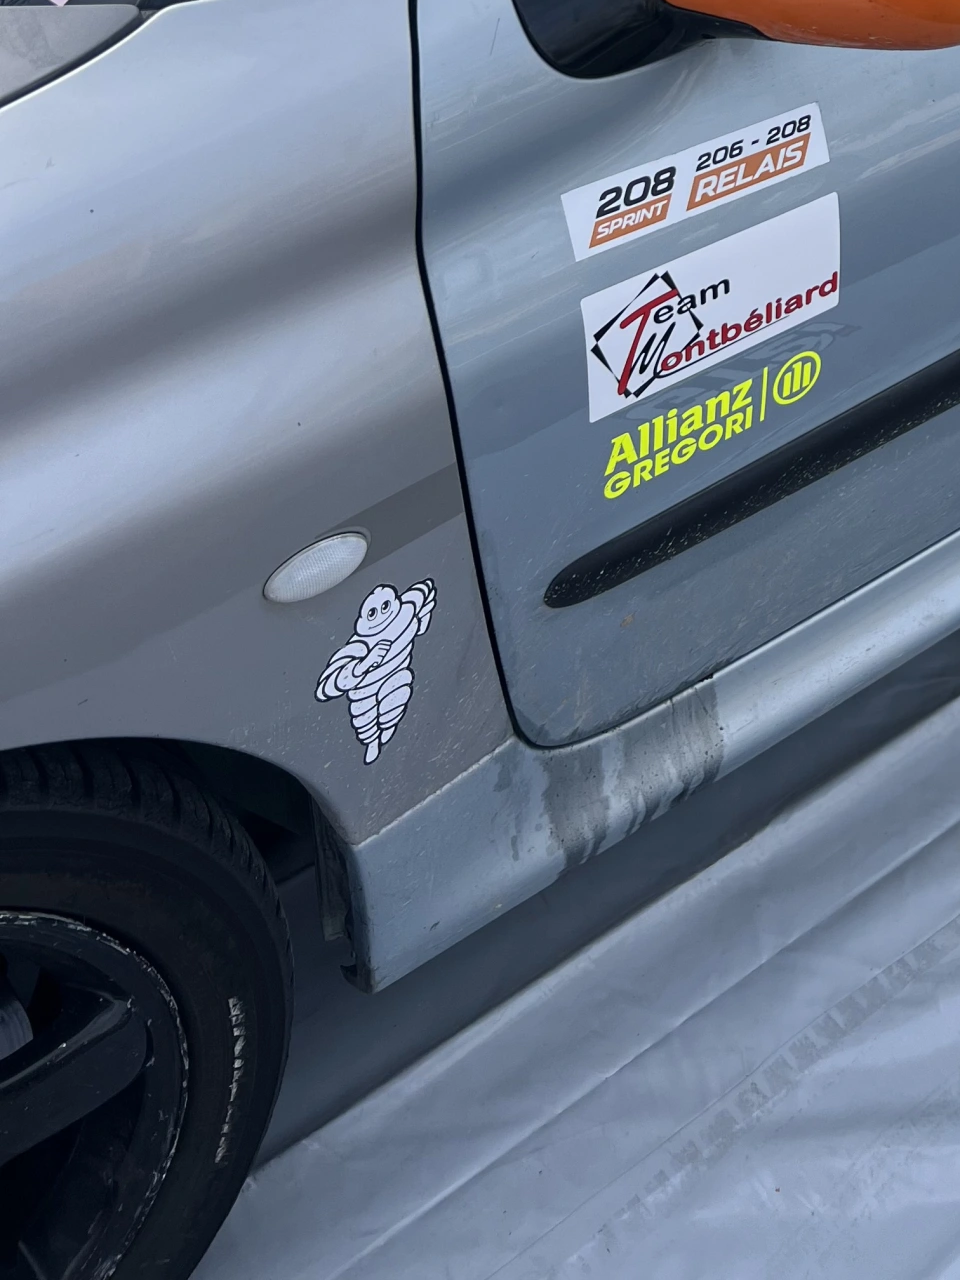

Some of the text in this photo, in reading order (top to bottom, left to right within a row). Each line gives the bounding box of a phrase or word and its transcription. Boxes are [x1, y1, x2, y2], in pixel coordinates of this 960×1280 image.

[694, 141, 804, 203] RELAIS
[695, 139, 744, 172] 206
[766, 114, 811, 145] 208
[595, 166, 677, 219] 208
[595, 199, 668, 239] SPRINT
[617, 278, 730, 396] Team
[631, 271, 838, 379] Montbéliard
[603, 405, 753, 500] GREGORI
[604, 378, 752, 476] Allianz
